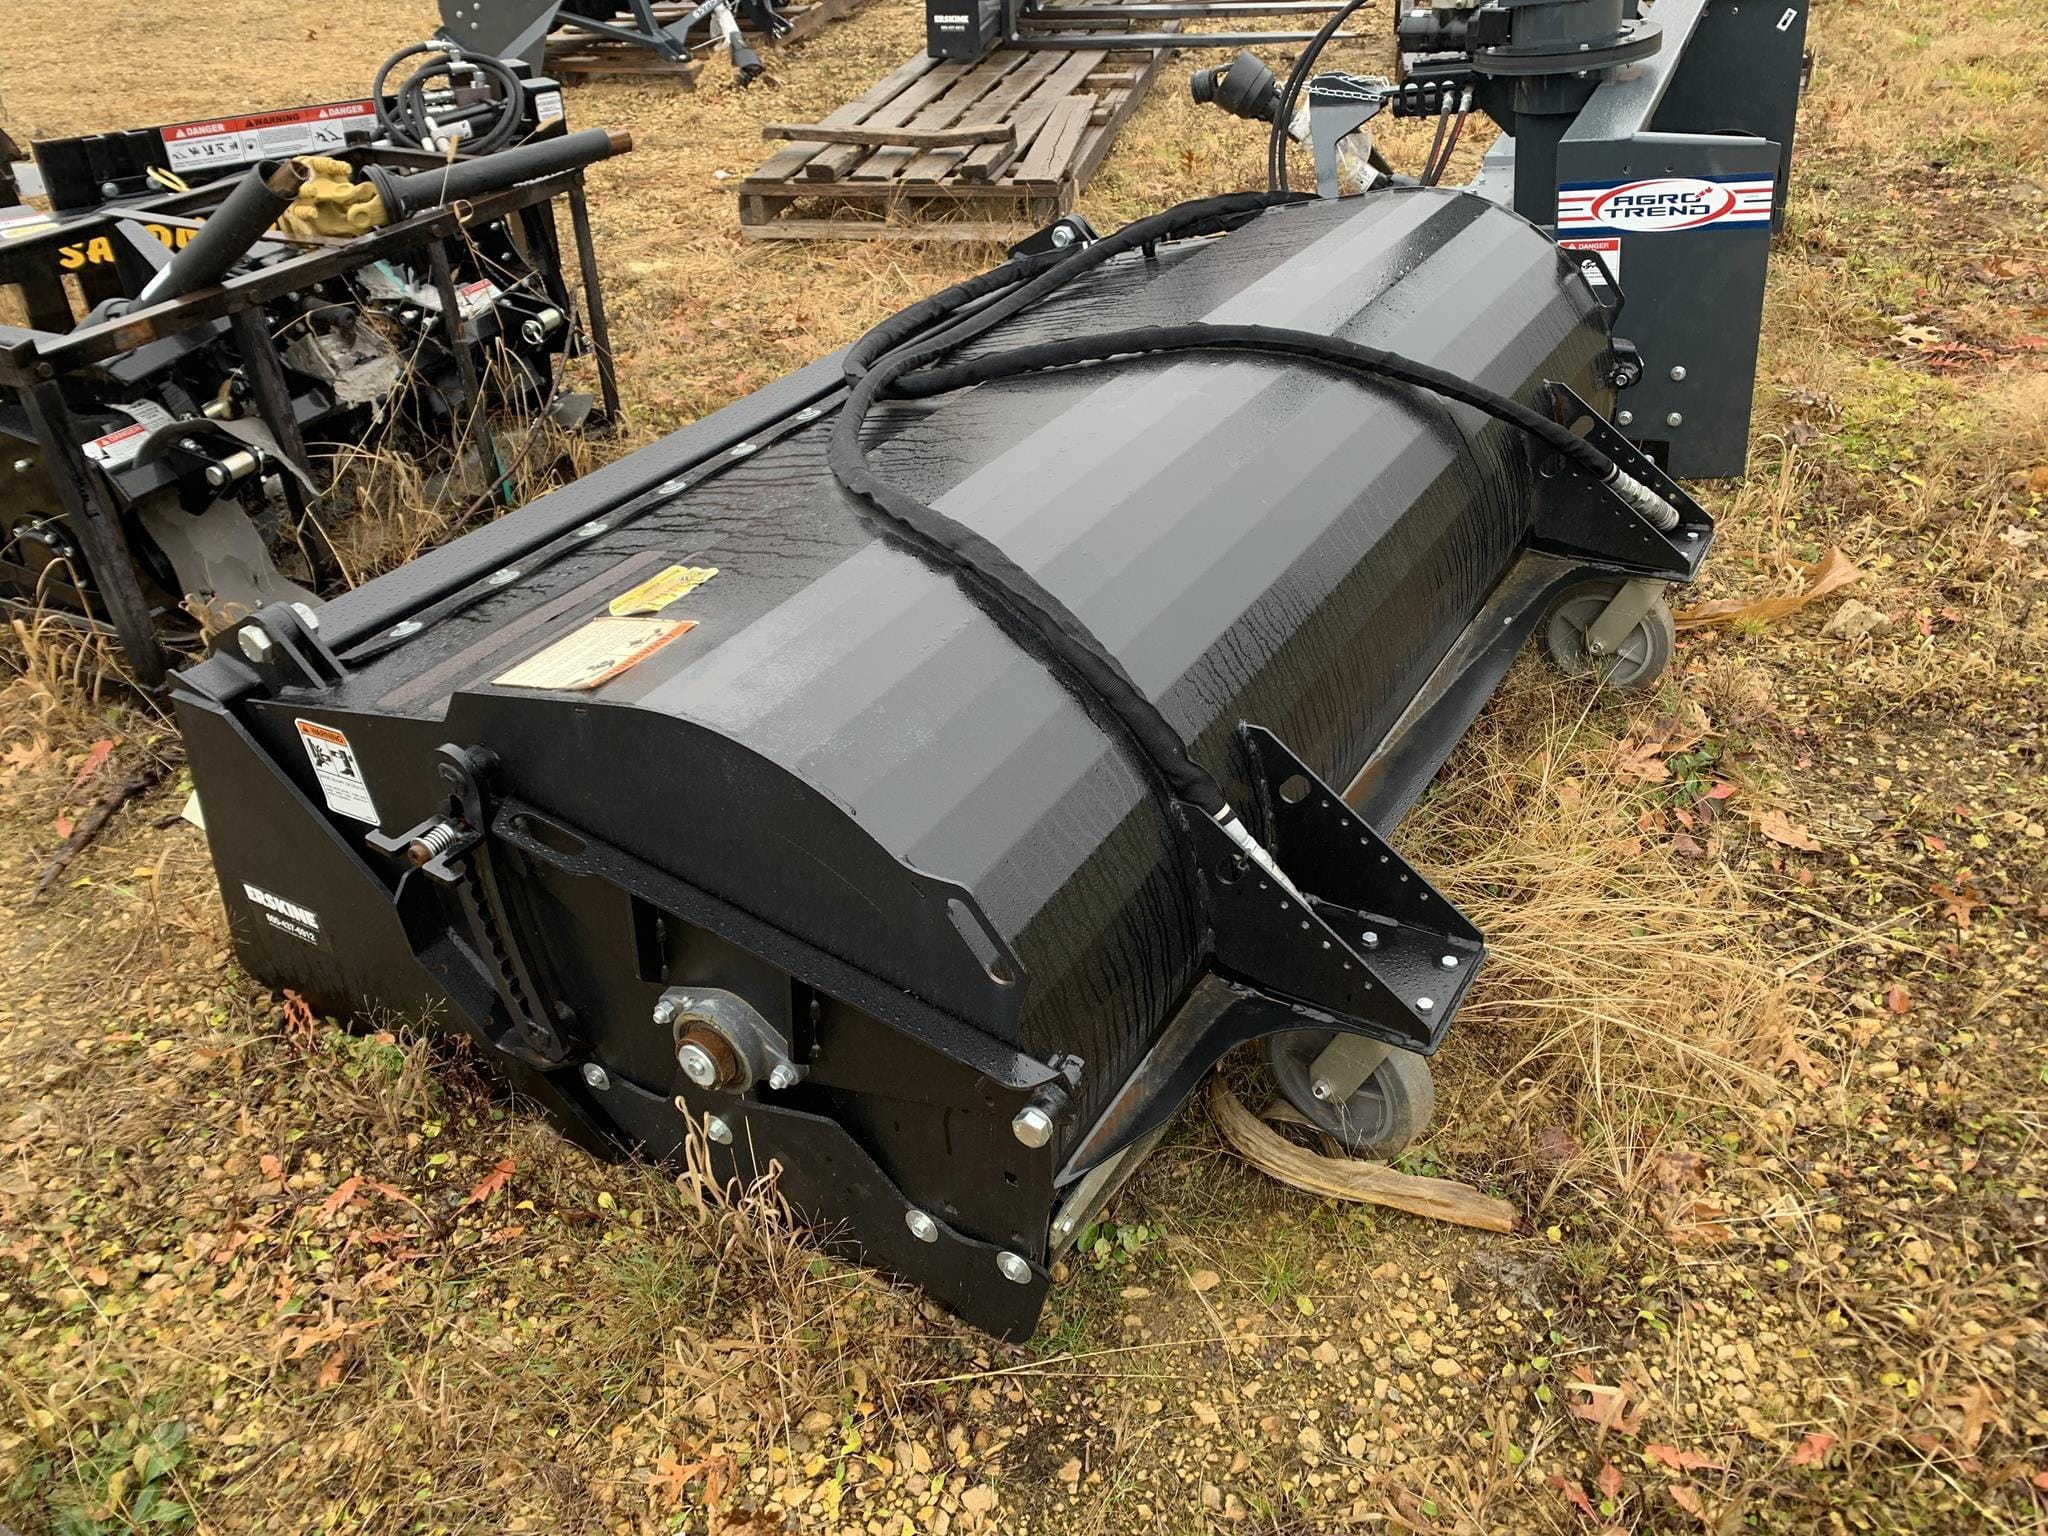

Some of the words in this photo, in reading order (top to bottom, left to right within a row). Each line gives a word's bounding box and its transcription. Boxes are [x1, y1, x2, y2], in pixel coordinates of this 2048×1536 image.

[934, 14, 970, 23] ERSKINE
[328, 104, 364, 117] DANGER
[253, 112, 300, 127] WARNING
[185, 123, 225, 137] DANGER
[1613, 192, 1701, 206] AGRO
[1604, 204, 1711, 218] TREND
[1578, 242, 1610, 250] DANGER
[310, 727, 344, 744] WARNING
[243, 883, 319, 930] ERSKINE
